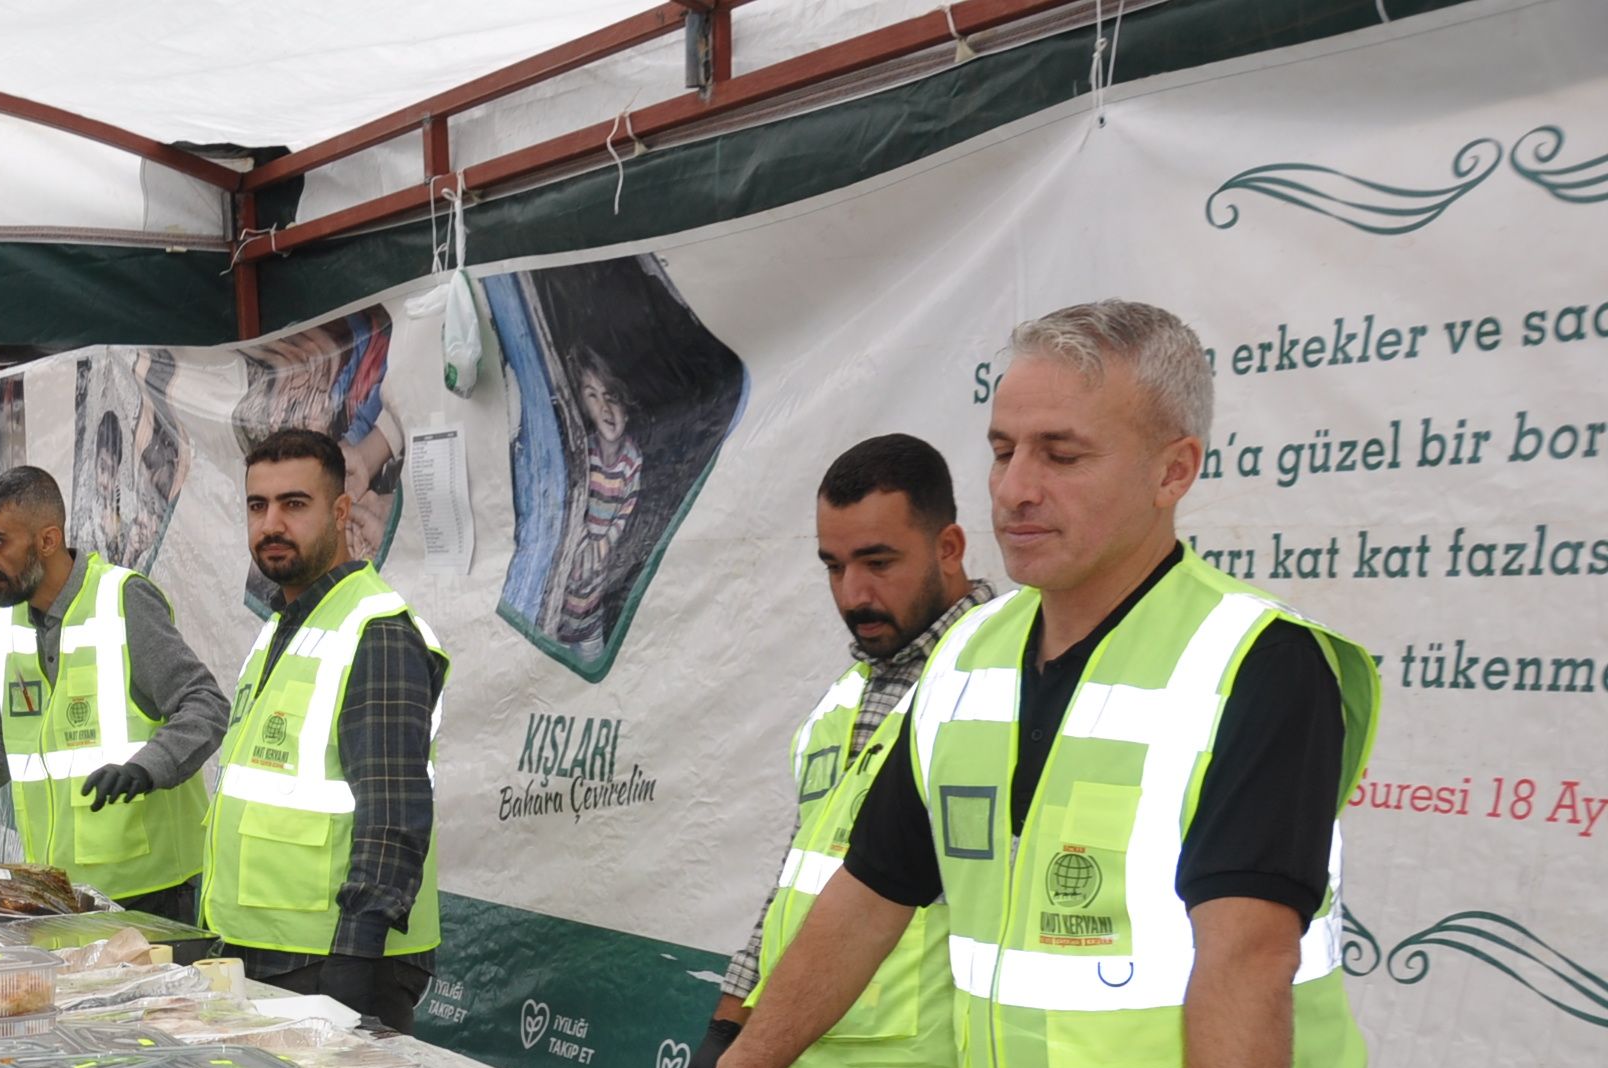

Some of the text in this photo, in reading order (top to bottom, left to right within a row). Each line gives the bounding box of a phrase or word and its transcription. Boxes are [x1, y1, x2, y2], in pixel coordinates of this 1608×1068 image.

[1231, 313, 1428, 376] erkekler
[1444, 315, 1502, 355] ve
[1276, 419, 1401, 488] güzel
[1417, 417, 1491, 468] bir
[1269, 531, 1339, 579] kat
[1352, 530, 1433, 579] kat
[518, 713, 622, 788] KIŞLARI
[499, 763, 657, 825] Bahara Çevirelim
[1486, 777, 1536, 820] 18
[578, 1048, 595, 1065] ET
